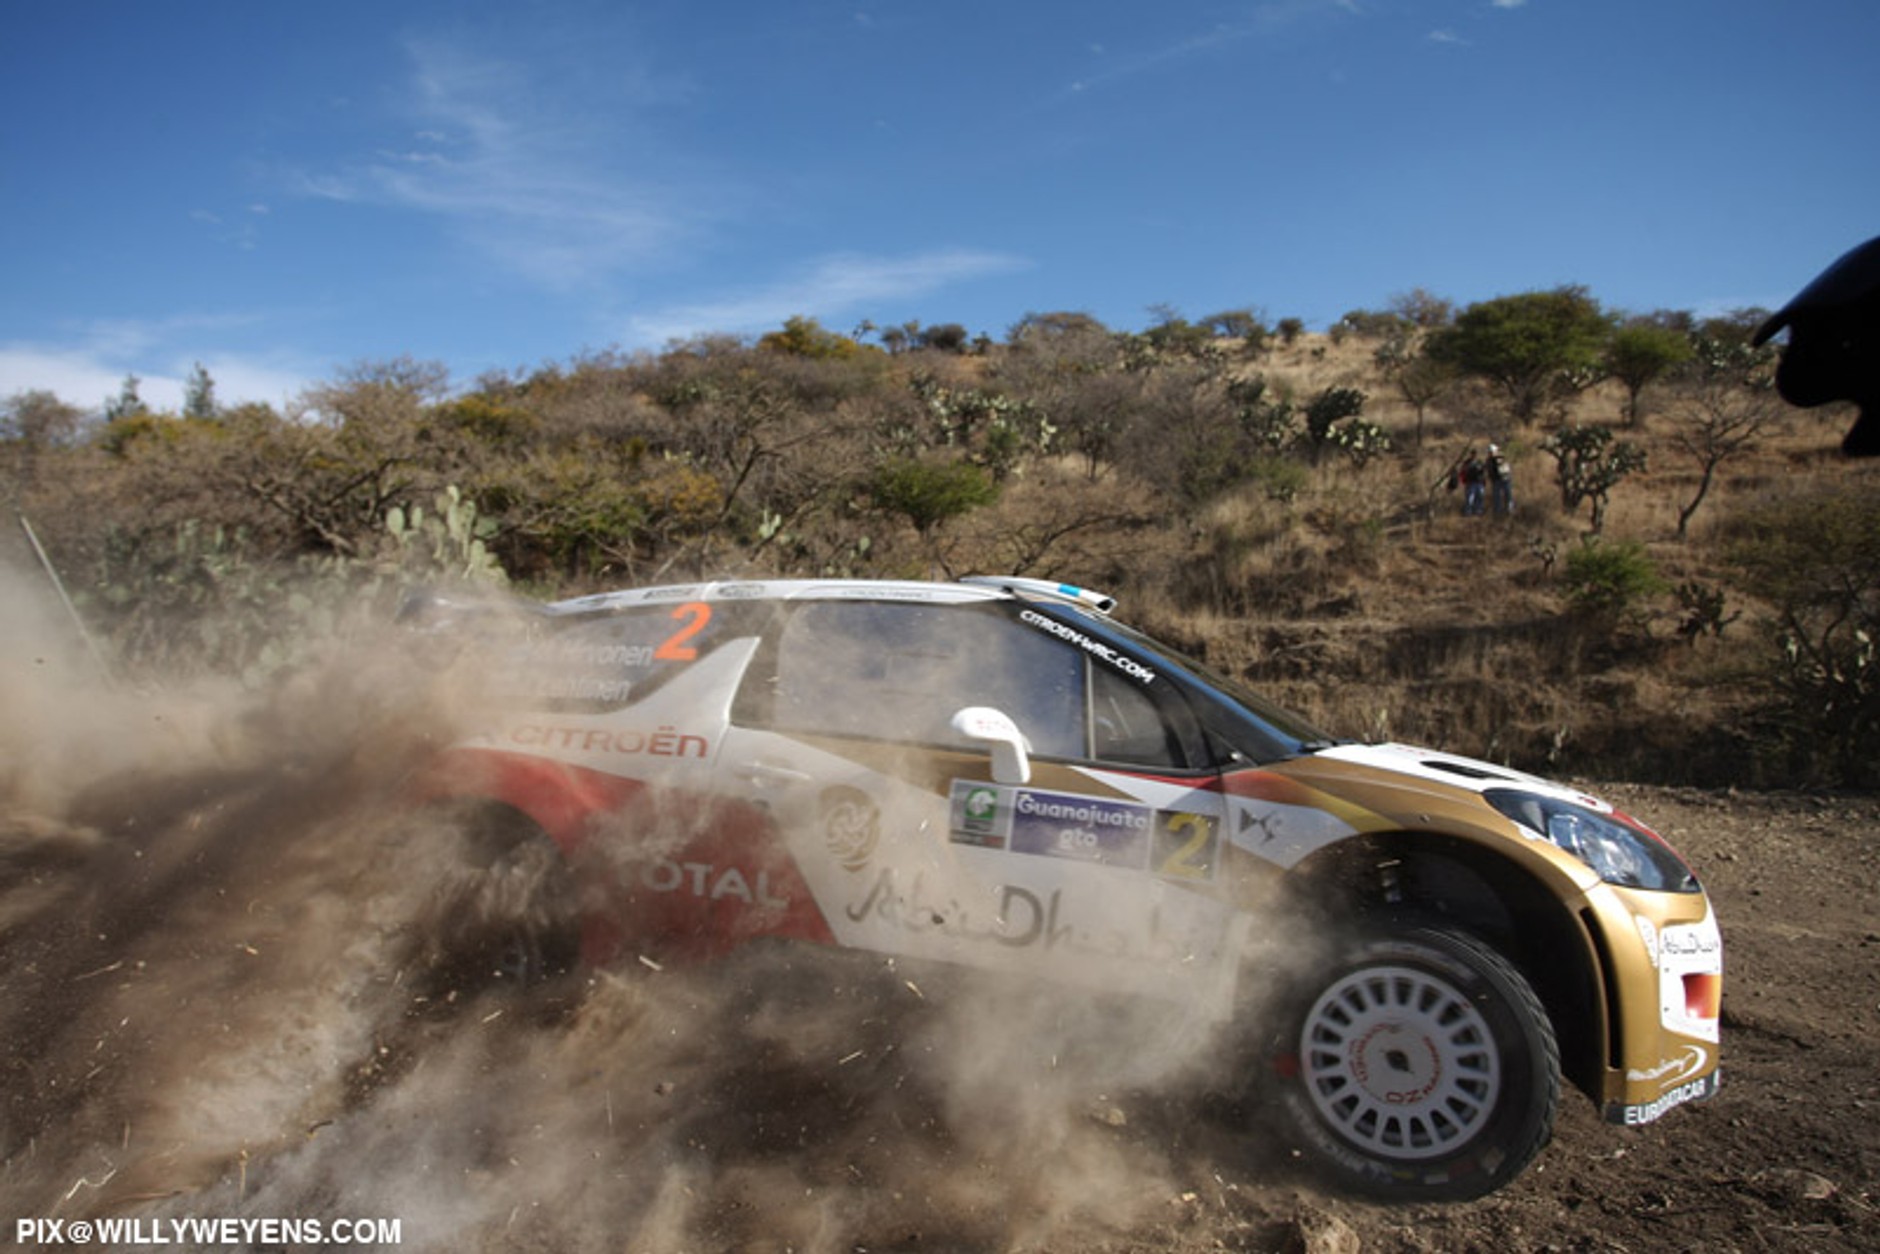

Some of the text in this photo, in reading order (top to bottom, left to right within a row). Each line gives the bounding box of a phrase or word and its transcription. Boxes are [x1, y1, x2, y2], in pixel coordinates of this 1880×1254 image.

[653, 601, 713, 661] 2
[1017, 793, 1149, 830] Guanajuato
[1058, 827, 1098, 850] gto
[1161, 812, 1211, 878] 2
